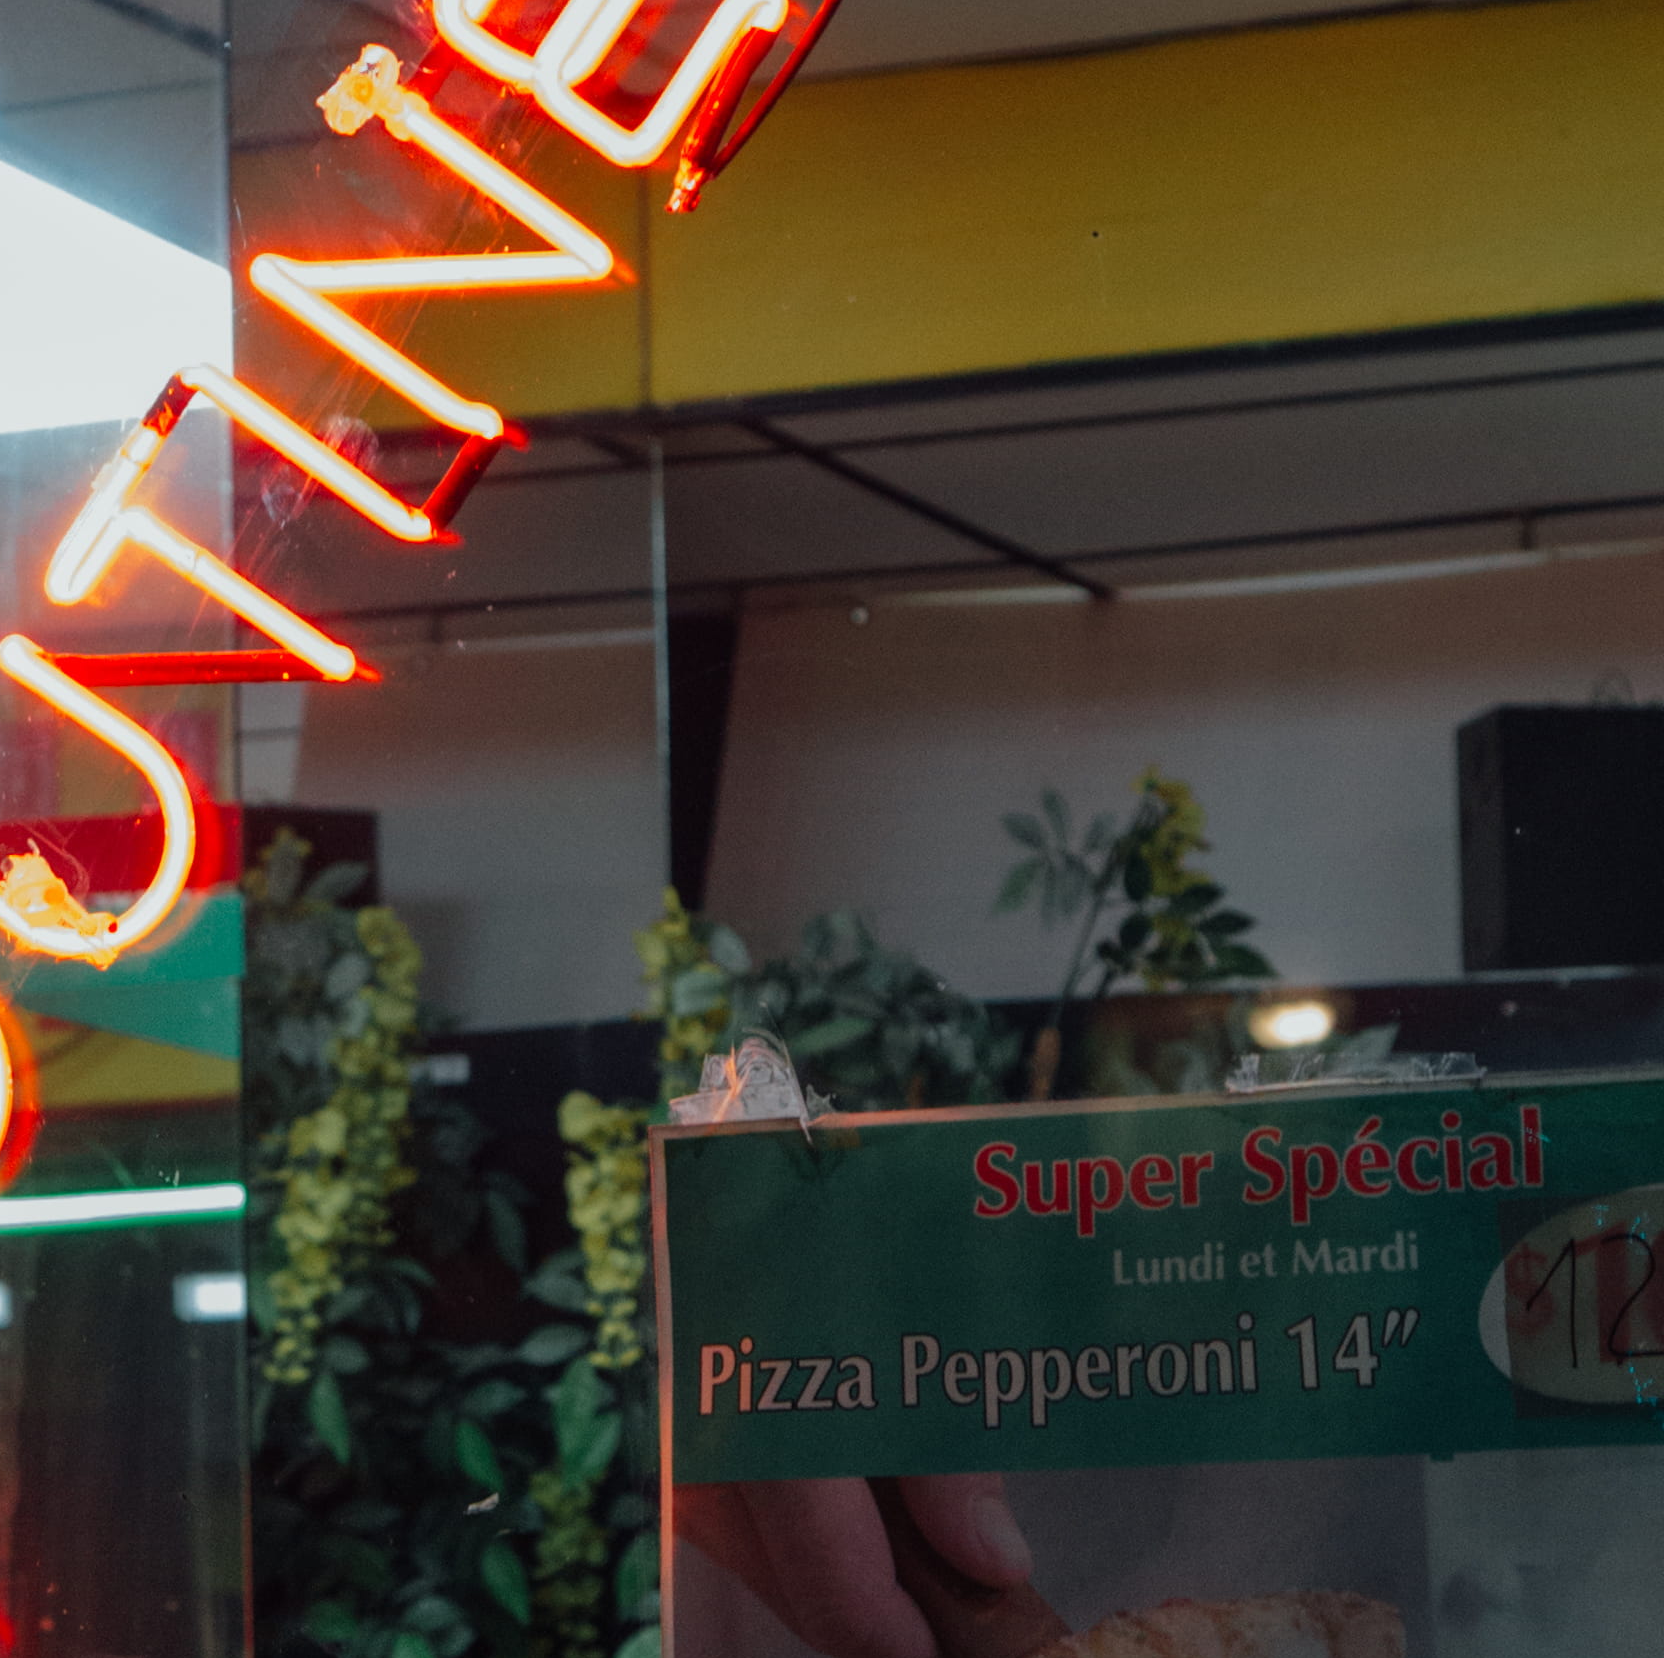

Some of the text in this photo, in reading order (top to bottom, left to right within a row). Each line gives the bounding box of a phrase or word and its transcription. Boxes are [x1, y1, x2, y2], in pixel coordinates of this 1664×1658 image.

[973, 1104, 1545, 1238] Super Spécial
[1113, 1231, 1420, 1287] Lundi et Mardi
[698, 1337, 877, 1417] Pizza
[902, 1310, 1259, 1430] Pepperoni
